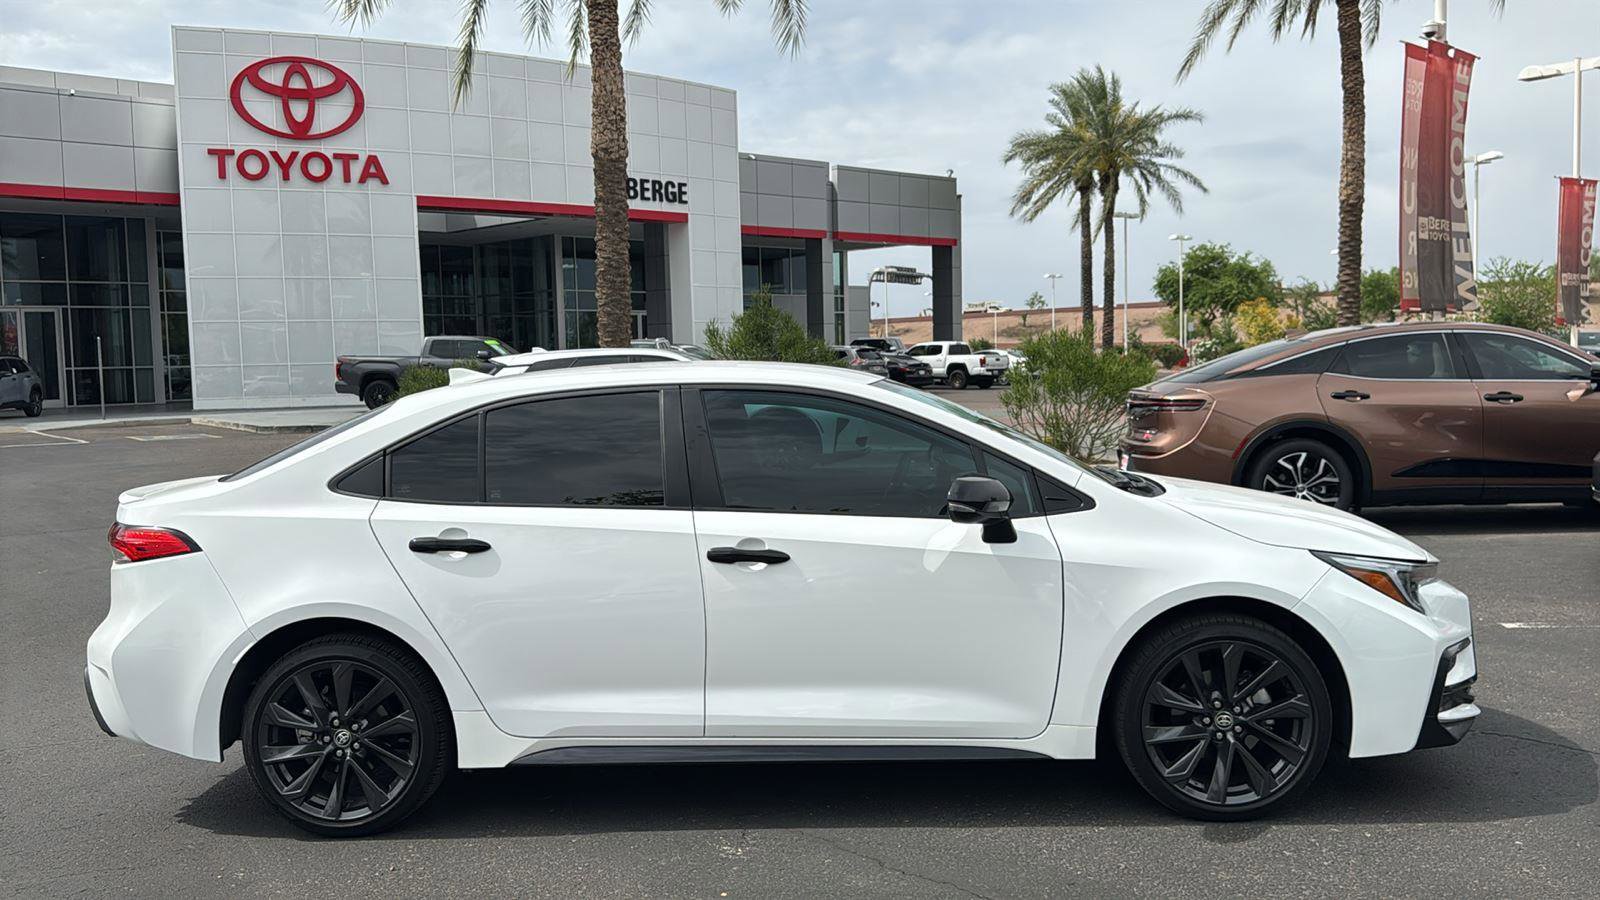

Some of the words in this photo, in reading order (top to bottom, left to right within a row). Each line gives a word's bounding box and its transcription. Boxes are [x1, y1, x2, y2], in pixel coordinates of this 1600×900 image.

[207, 148, 390, 185] TOYOTA
[627, 177, 688, 204] BERGE
[1450, 57, 1479, 311] WELCOME
[1580, 183, 1595, 324] WELCOME
